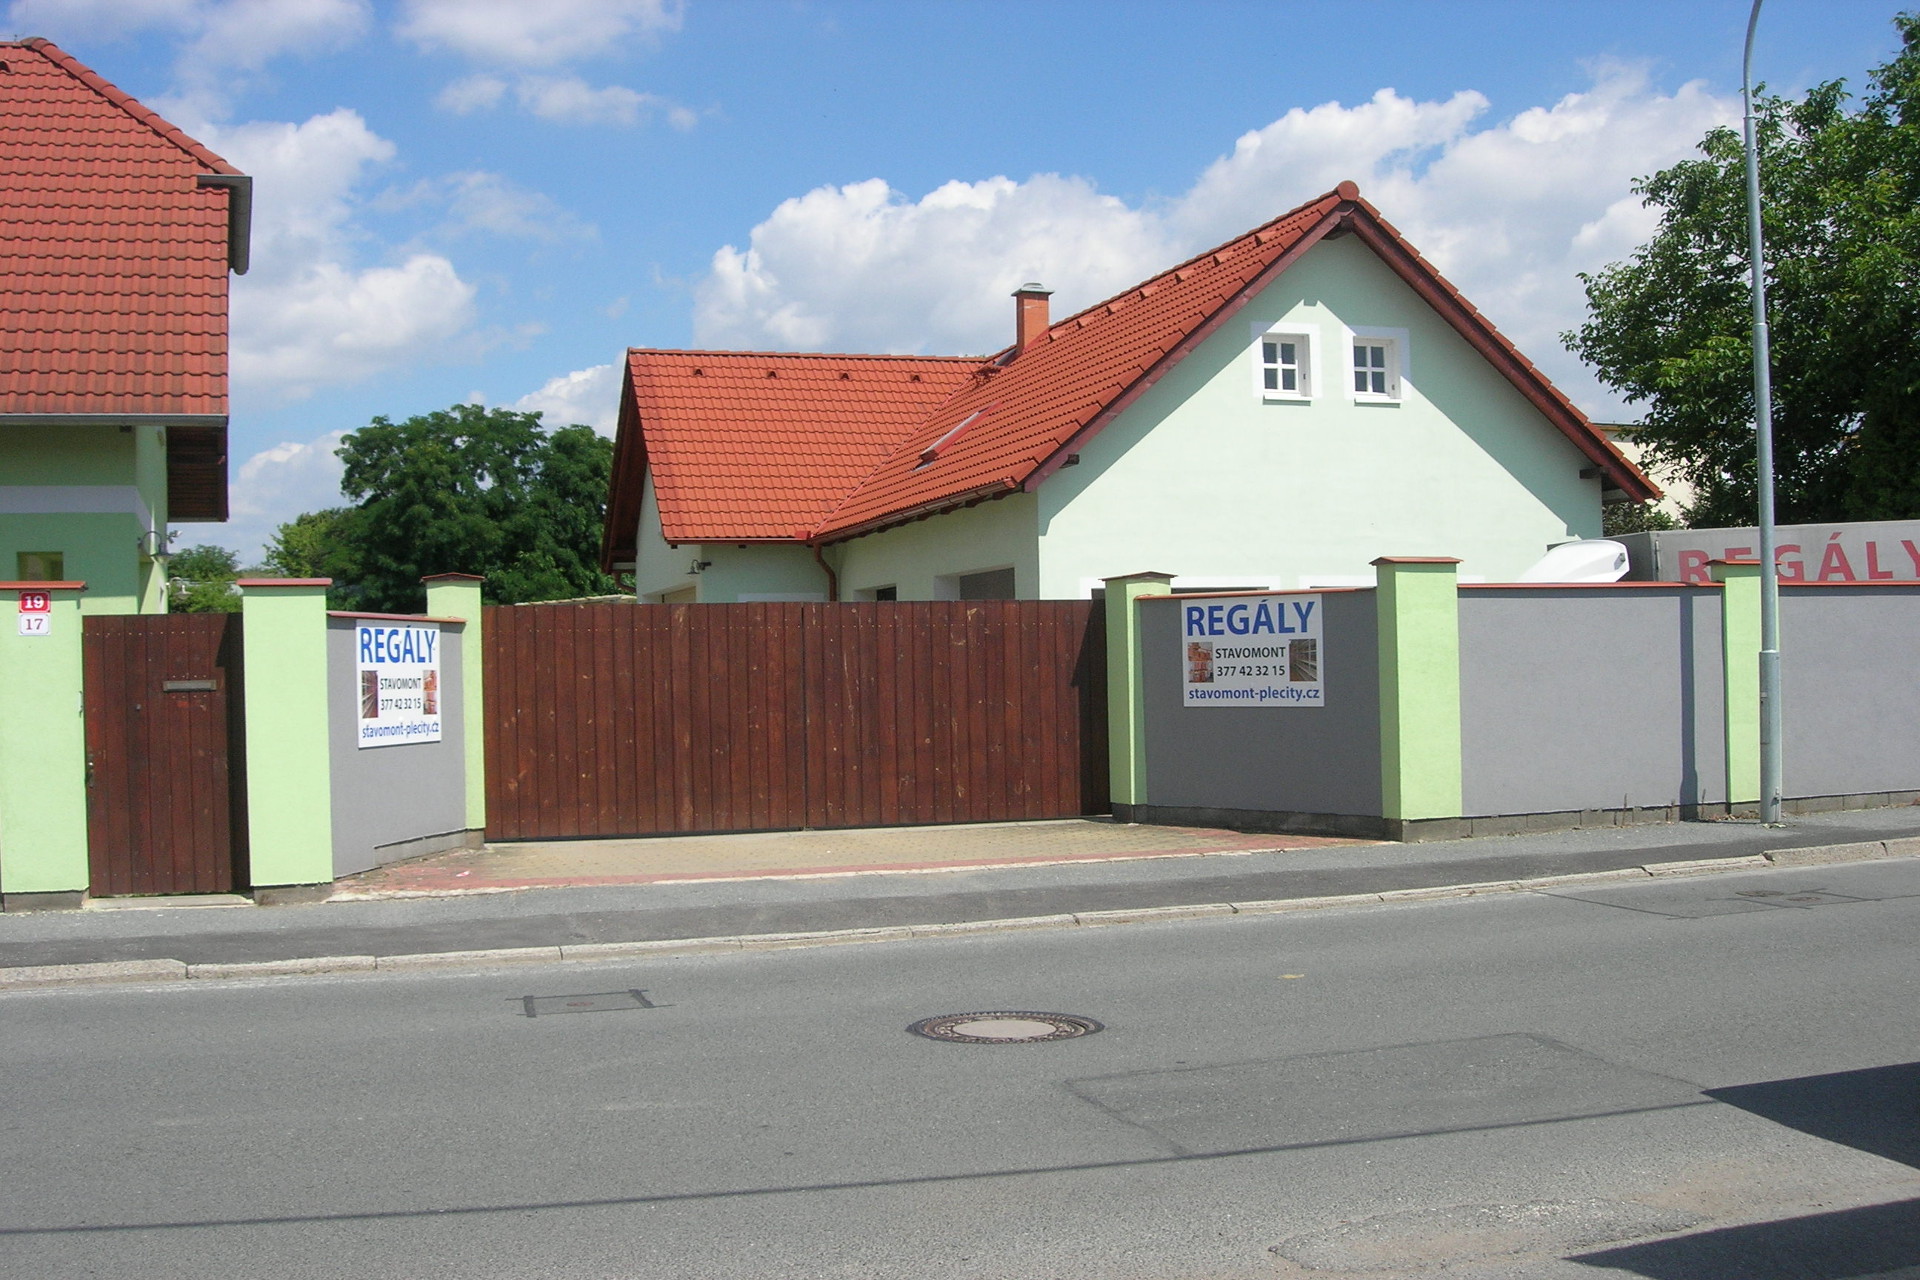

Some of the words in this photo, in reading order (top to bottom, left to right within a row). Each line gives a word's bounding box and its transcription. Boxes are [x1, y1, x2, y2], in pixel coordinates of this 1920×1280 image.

[25, 595, 45, 609] 19
[1186, 599, 1315, 636] REGÁLY
[26, 618, 43, 631] 17
[360, 625, 436, 663] REGÁLY
[1215, 647, 1286, 659] STAVOMONT
[1217, 666, 1236, 677] 377
[1239, 666, 1252, 676] 42
[1255, 665, 1269, 676] 32
[1273, 665, 1286, 676] 15
[380, 678, 422, 690] STAVOMONT
[1189, 686, 1320, 702] stavomont-plecity.cz
[380, 699, 393, 711] 377
[394, 699, 403, 710] 42
[404, 698, 412, 709] 32
[413, 698, 422, 709] 15
[362, 722, 439, 739] stavomont-plecity.cz
